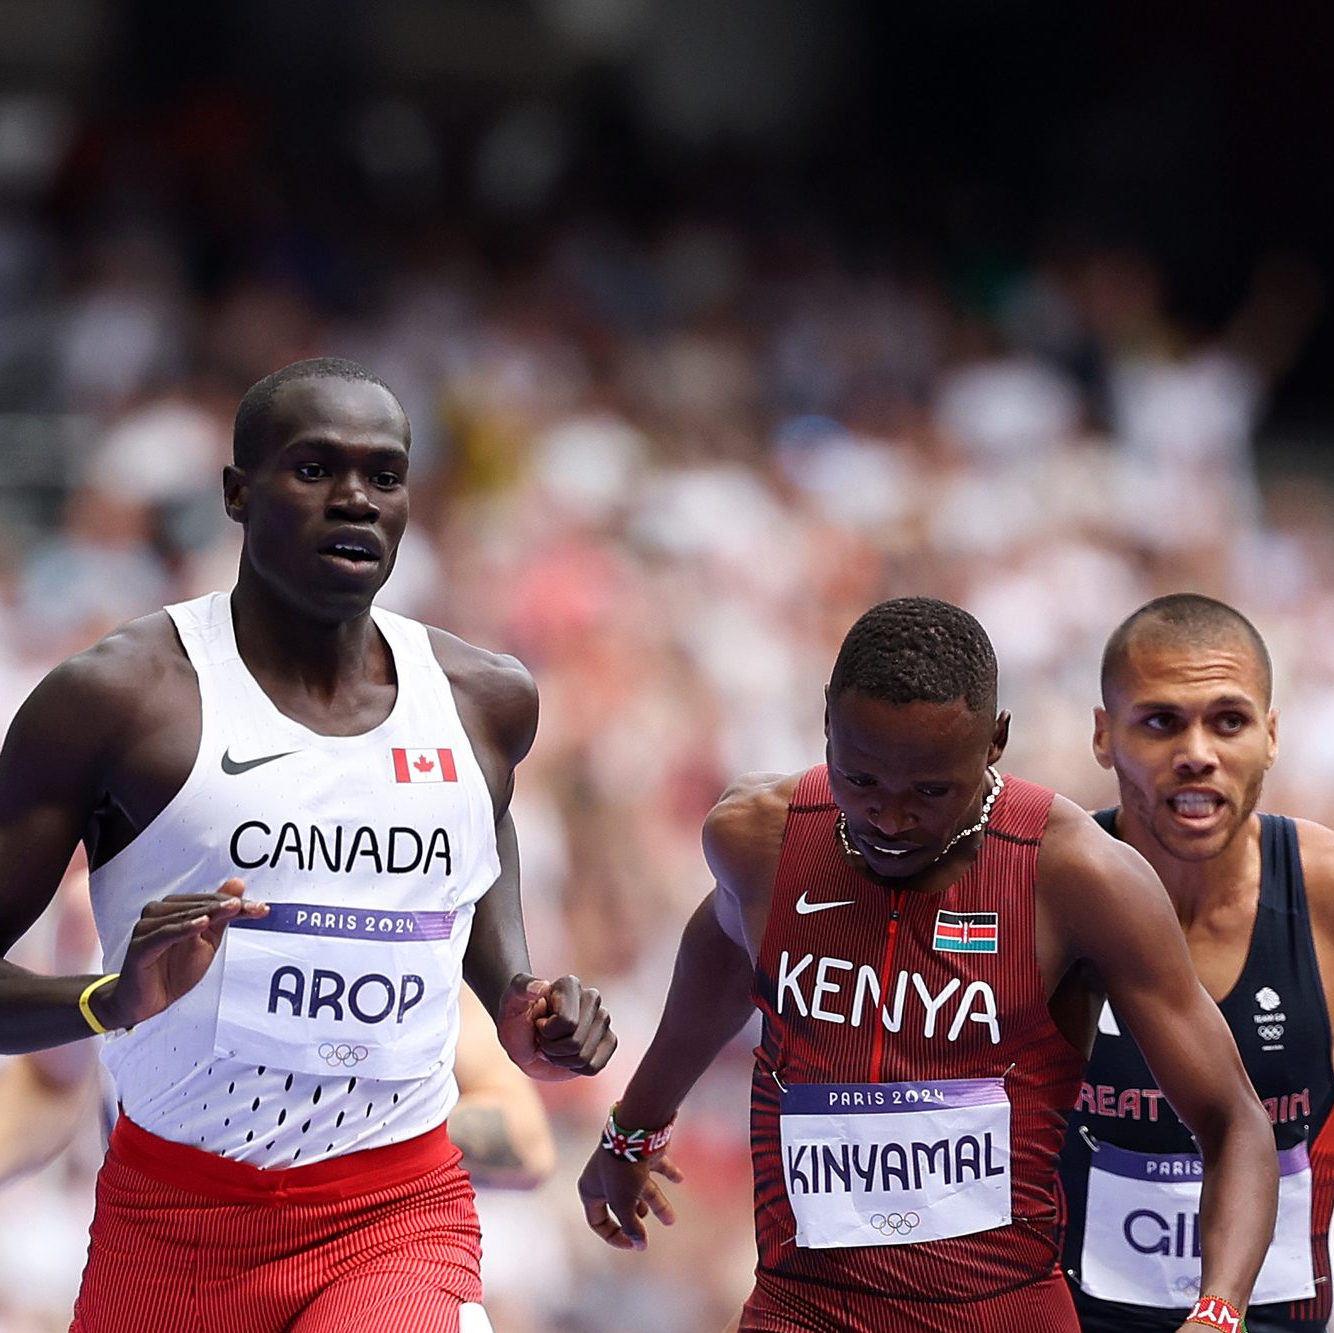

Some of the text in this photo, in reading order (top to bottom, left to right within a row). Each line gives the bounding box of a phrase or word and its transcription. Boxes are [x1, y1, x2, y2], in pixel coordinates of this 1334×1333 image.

[229, 820, 452, 876] CANADA
[296, 910, 414, 933] PARIS 2024
[267, 965, 425, 1024] AROP
[777, 951, 1001, 1045] KENYA
[829, 1089, 944, 1106] PARIS 2024
[1073, 1081, 1165, 1121] REAT
[787, 1132, 1005, 1195] KINYAMAL
[1146, 1160, 1203, 1176] PARIS
